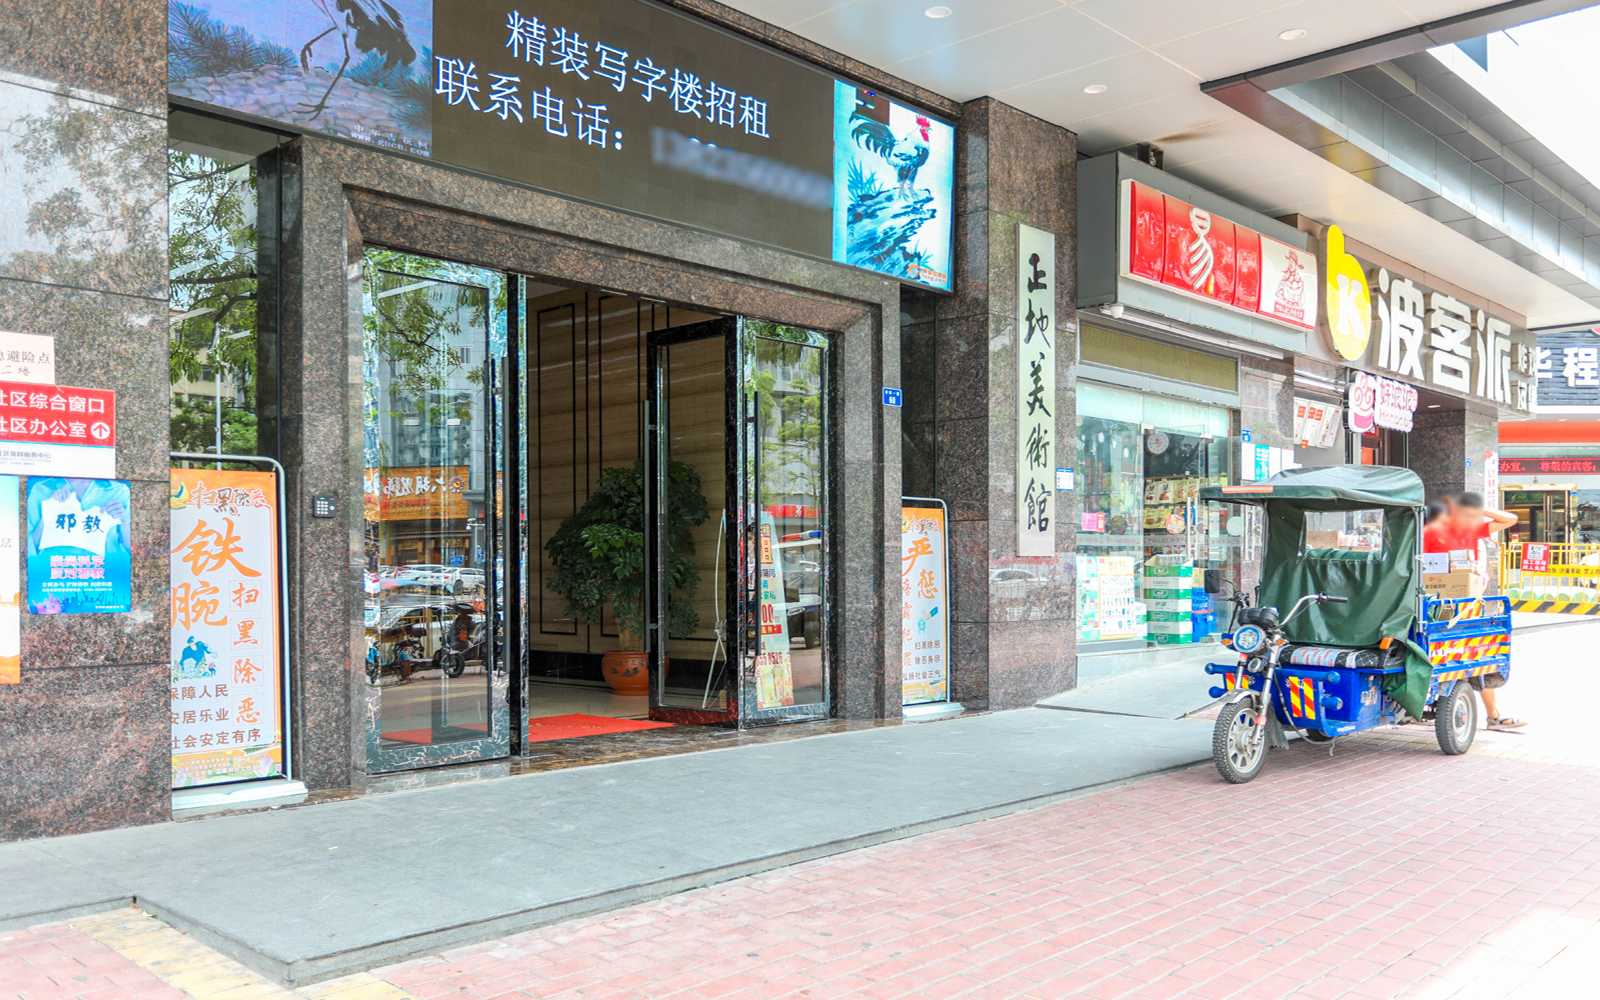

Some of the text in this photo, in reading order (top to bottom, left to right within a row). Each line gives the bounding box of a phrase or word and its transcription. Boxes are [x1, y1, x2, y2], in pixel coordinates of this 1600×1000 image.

[506, 10, 770, 140] 精装写字楼招租
[351, 132, 430, 157] www.gucn.com
[1336, 273, 1366, 341] K
[1377, 267, 1512, 405] 波客派
[55, 513, 104, 533] 邪教
[50, 555, 105, 567] 崇尚科学
[50, 567, 105, 579] 反对邪教
[231, 582, 263, 724] 扫黑除恶
[171, 708, 230, 725] 安居乐业
